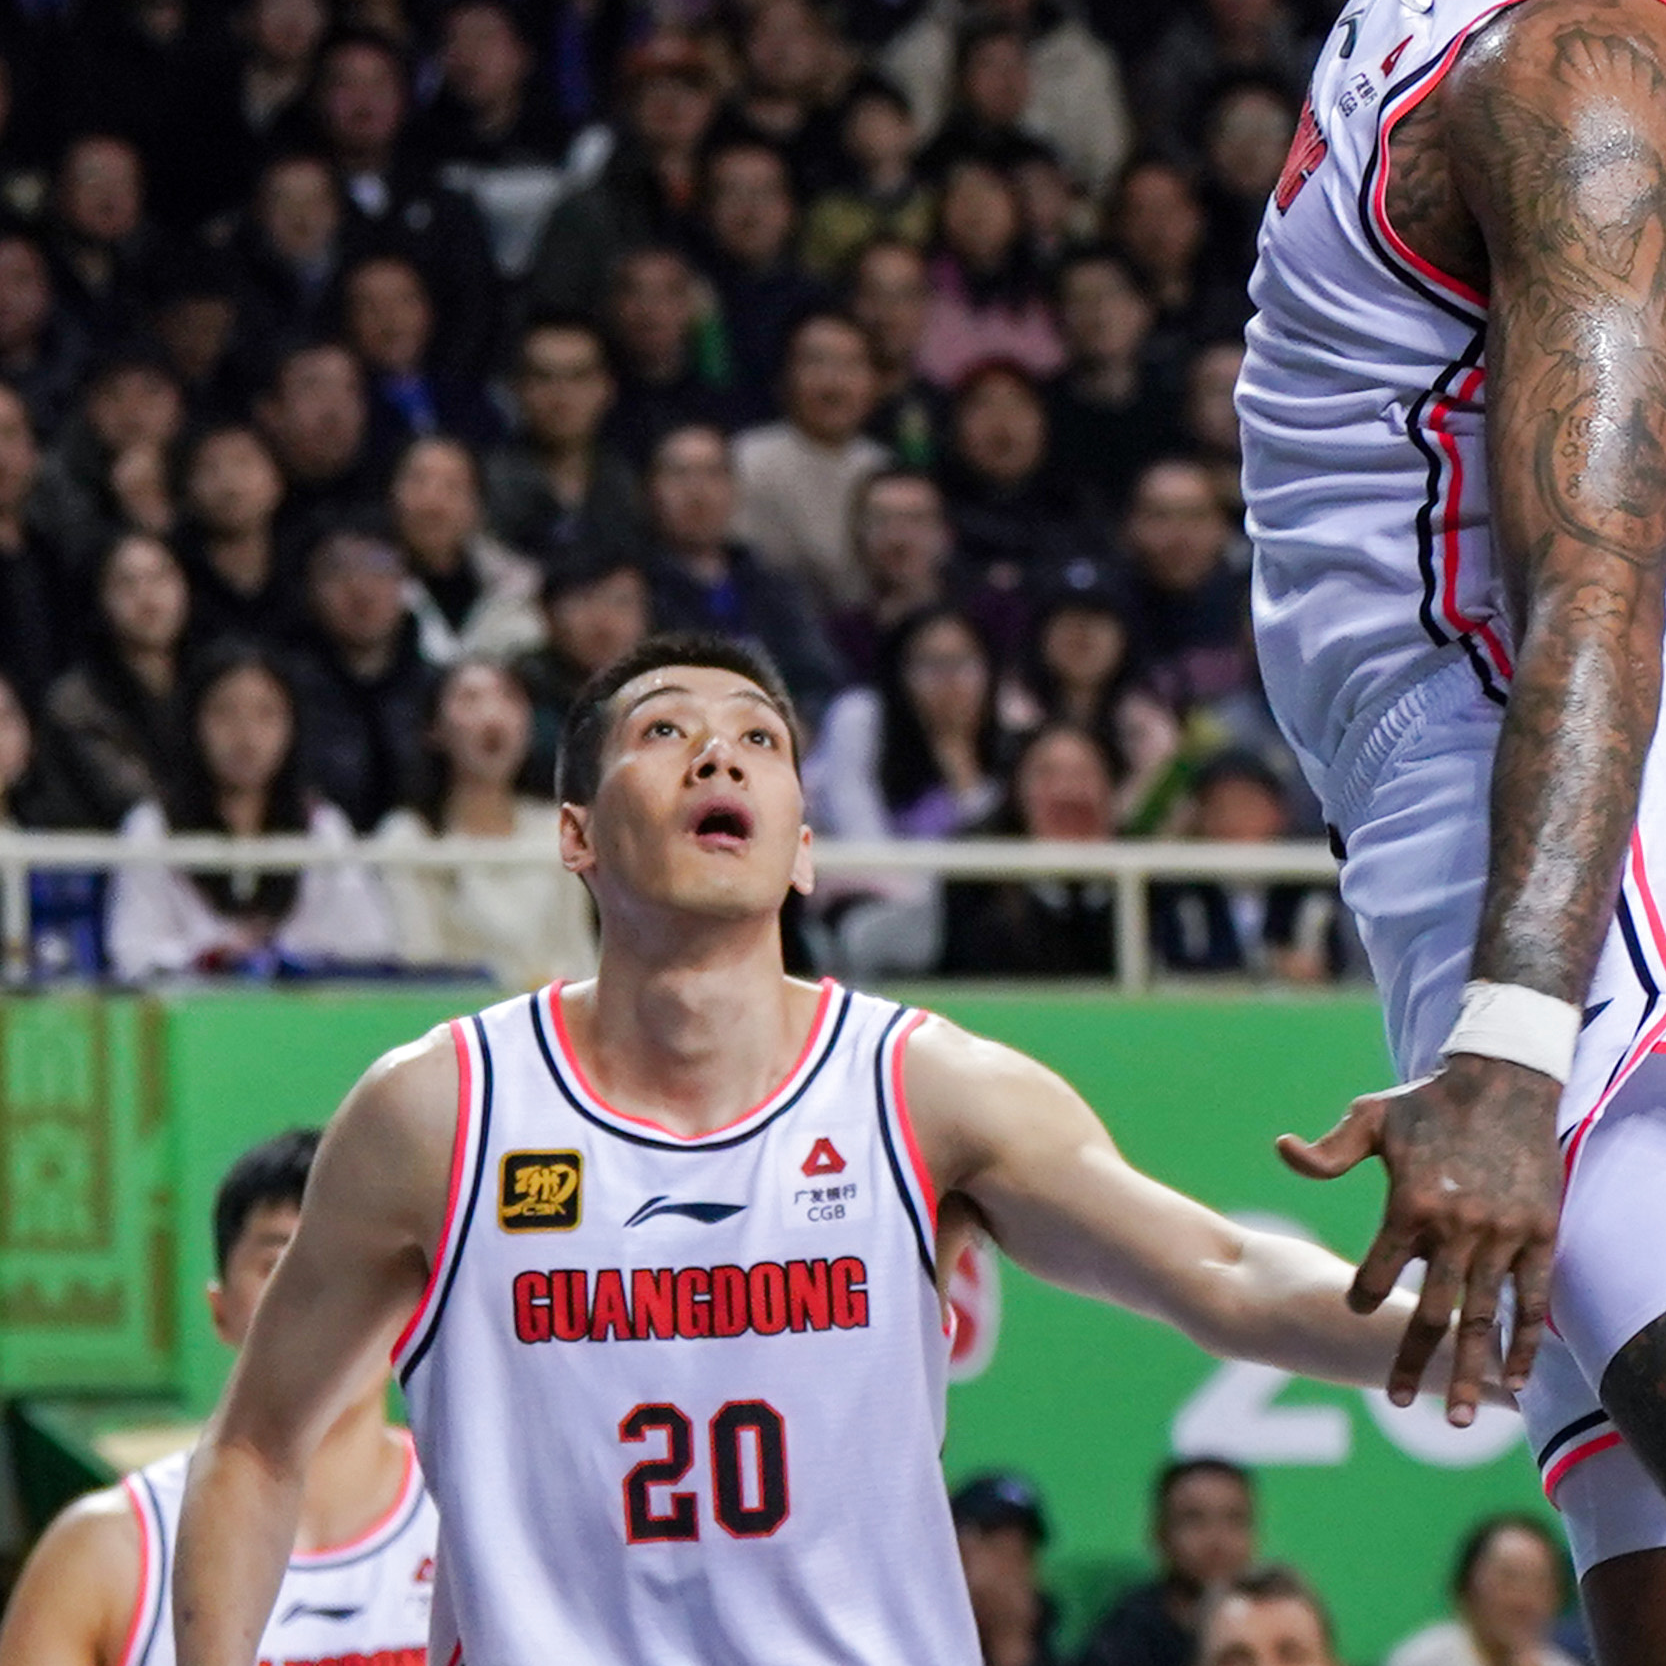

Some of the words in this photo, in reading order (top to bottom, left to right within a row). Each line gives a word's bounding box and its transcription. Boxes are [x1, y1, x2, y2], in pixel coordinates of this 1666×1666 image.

[806, 1203, 846, 1223] CGB
[512, 1255, 870, 1345] GUANGDONG
[617, 1398, 790, 1545] 20
